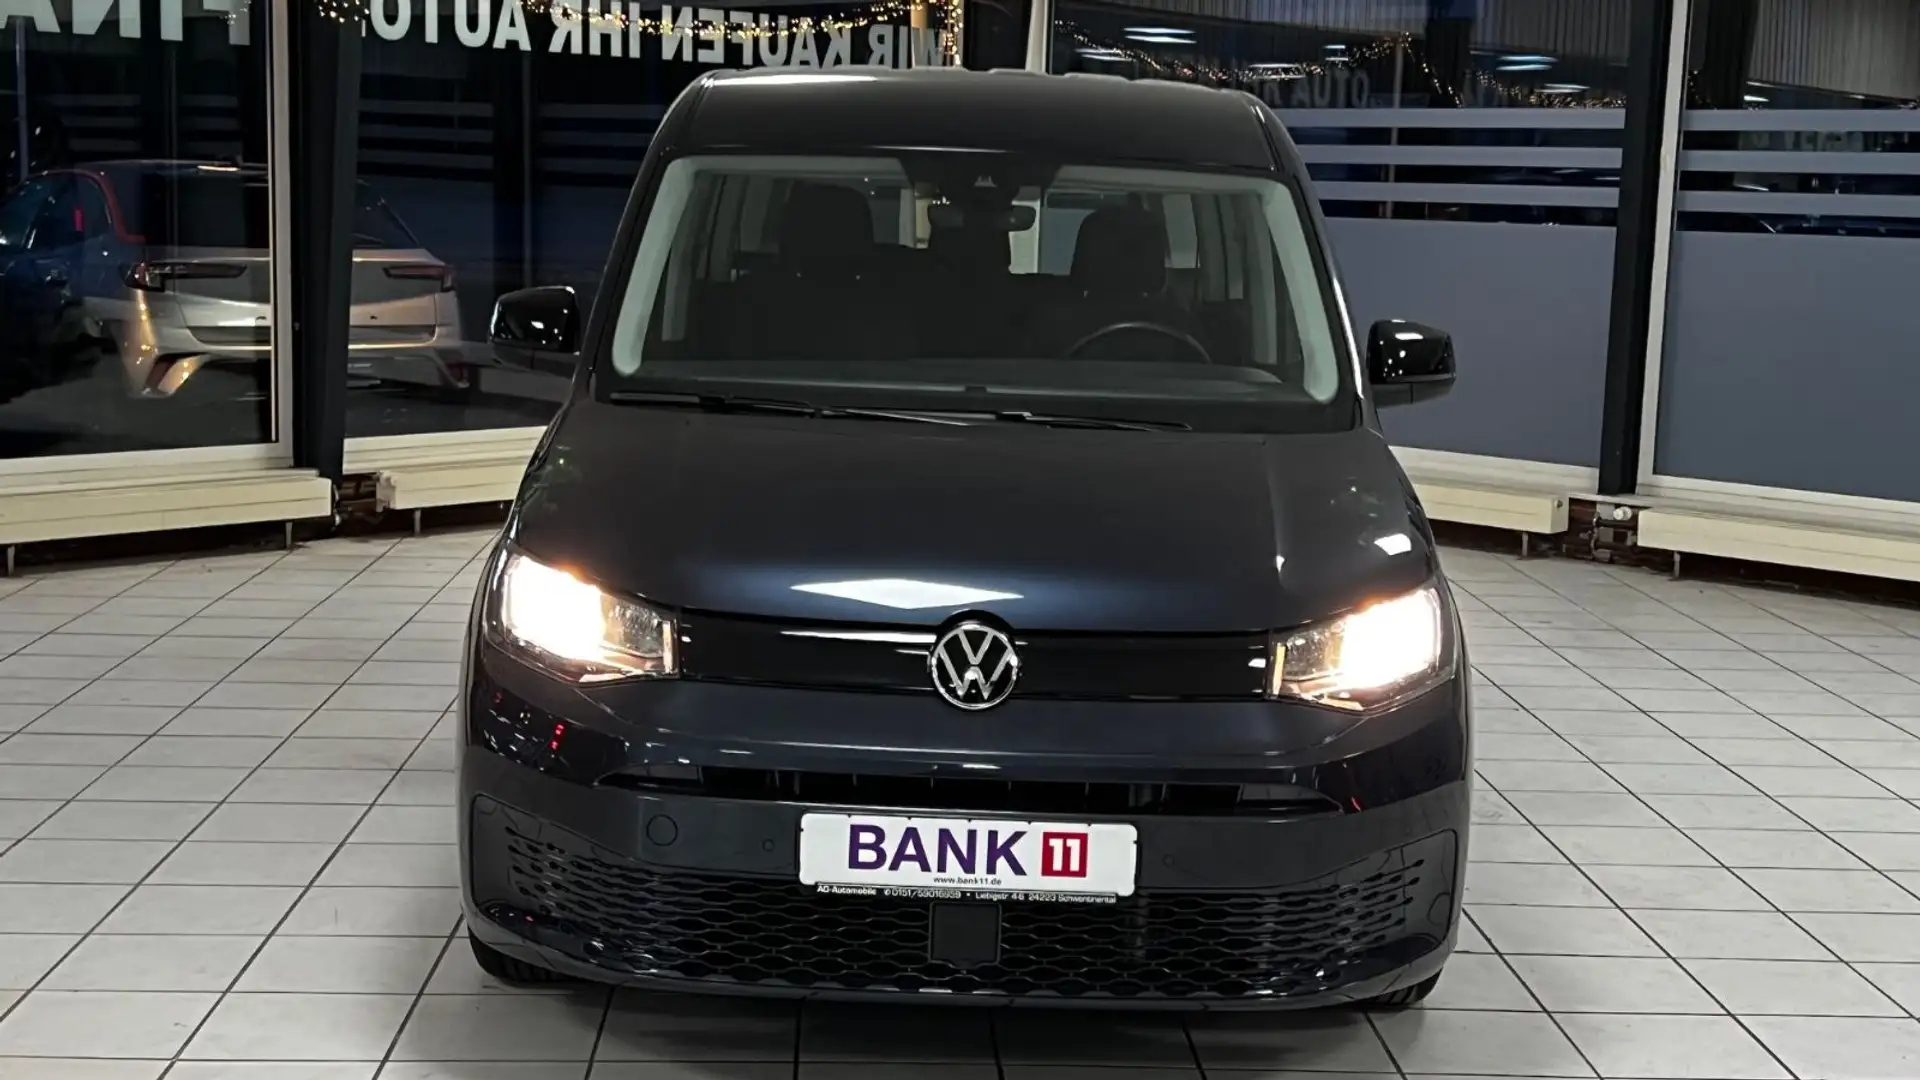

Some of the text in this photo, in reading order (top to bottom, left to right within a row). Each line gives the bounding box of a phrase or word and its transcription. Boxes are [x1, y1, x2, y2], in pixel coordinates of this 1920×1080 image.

[849, 823, 1081, 876] BANK 11
[933, 876, 1002, 886] www.bank11.de
